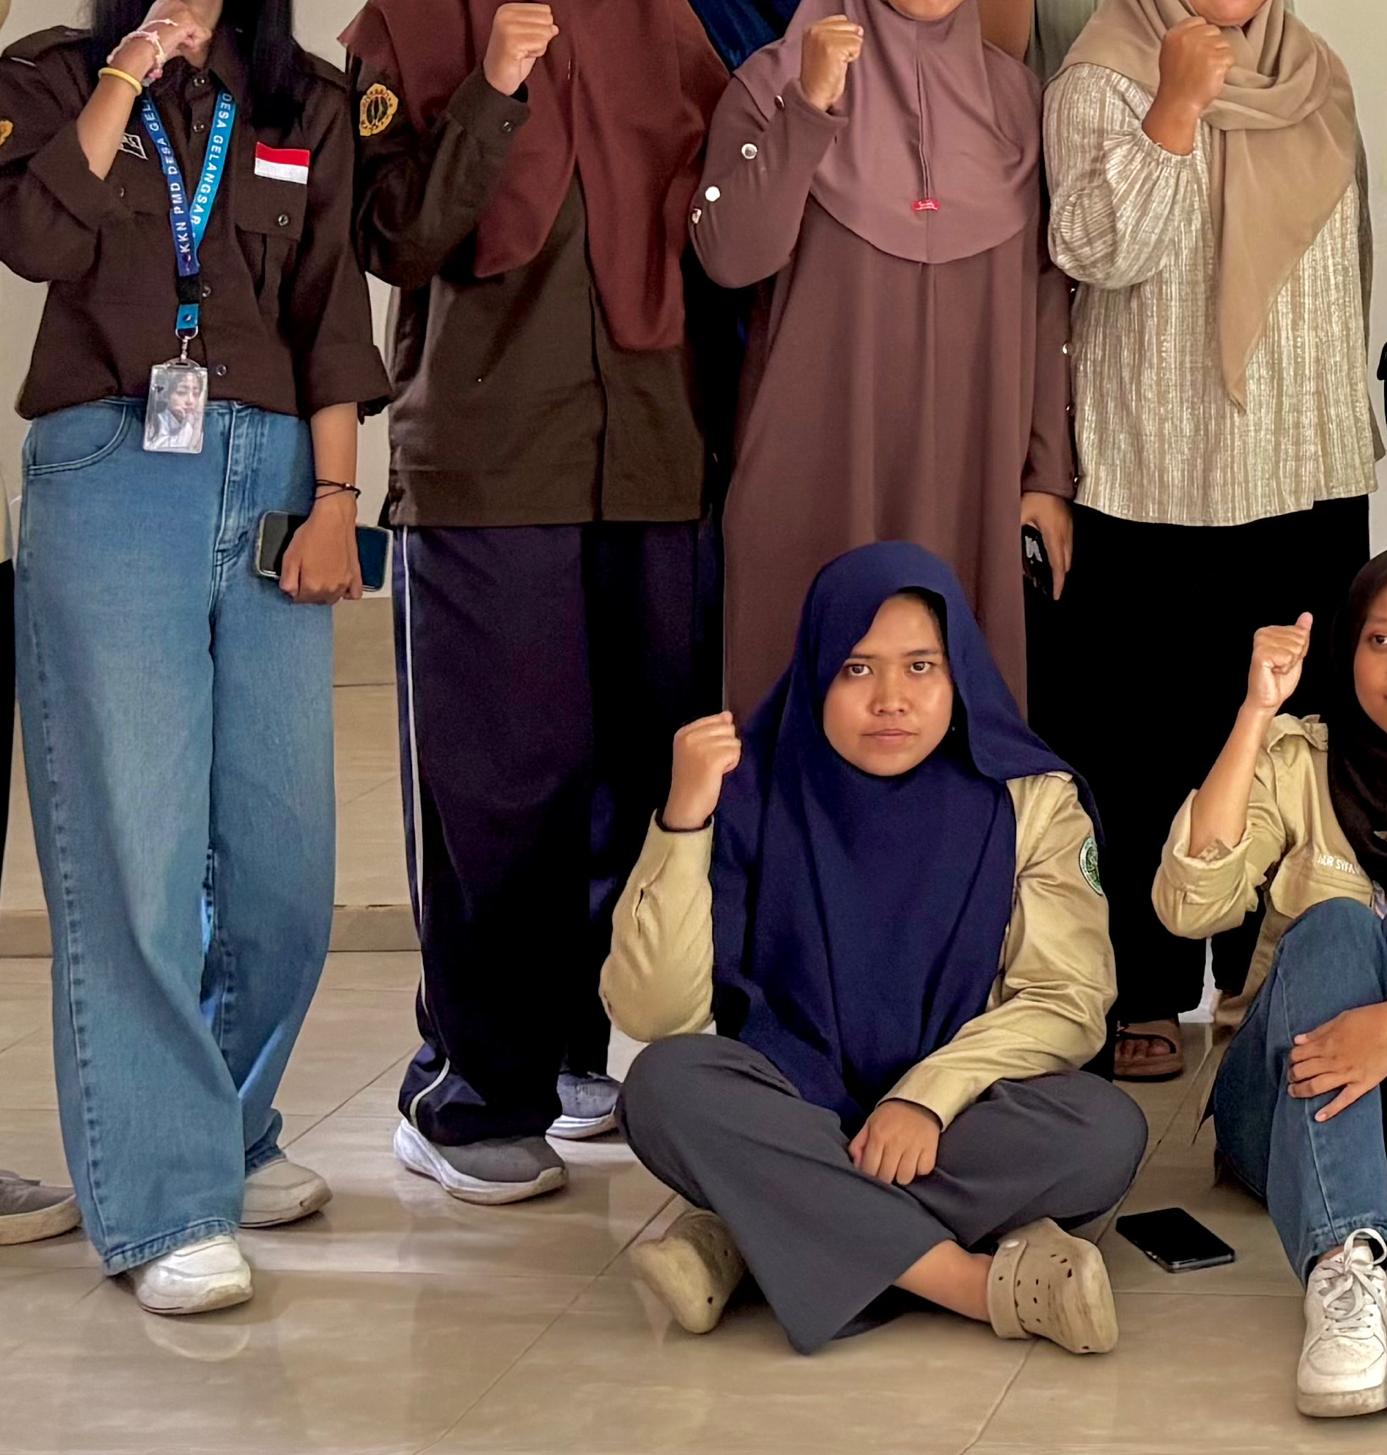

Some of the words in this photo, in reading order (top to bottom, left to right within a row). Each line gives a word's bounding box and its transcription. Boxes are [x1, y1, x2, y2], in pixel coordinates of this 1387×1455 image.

[215, 92, 233, 129] DESA
[157, 137, 178, 175] DESA
[190, 134, 224, 225] GELANGSAR
[169, 182, 184, 215] PMD
[176, 221, 191, 253] KKN
